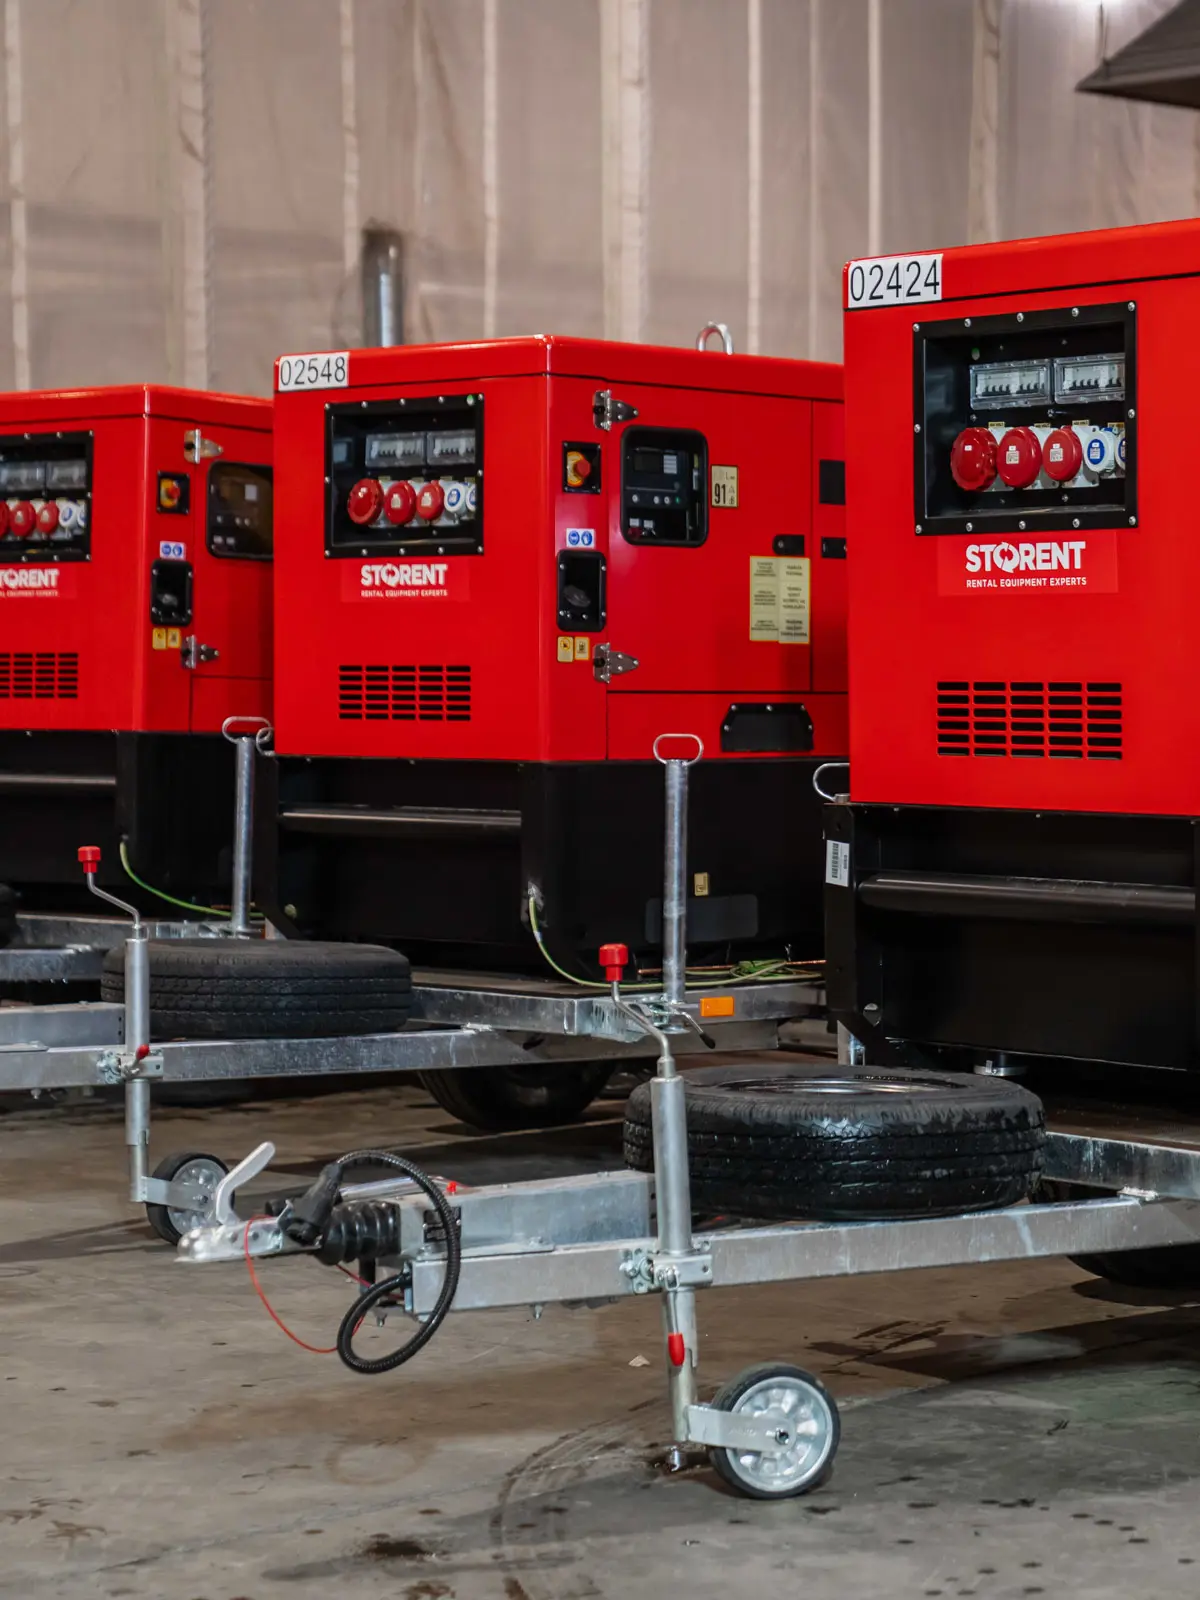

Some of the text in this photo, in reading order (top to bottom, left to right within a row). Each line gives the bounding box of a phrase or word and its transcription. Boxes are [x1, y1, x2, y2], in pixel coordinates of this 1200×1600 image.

[850, 259, 940, 301] 02424
[280, 356, 346, 386] 02548
[714, 483, 726, 505] 91
[965, 541, 1087, 574] STORENT
[361, 563, 448, 587] STORENT
[966, 576, 1087, 588] RENTAL EQUIPMENT EXPERTS
[361, 589, 384, 598] RENTAL
